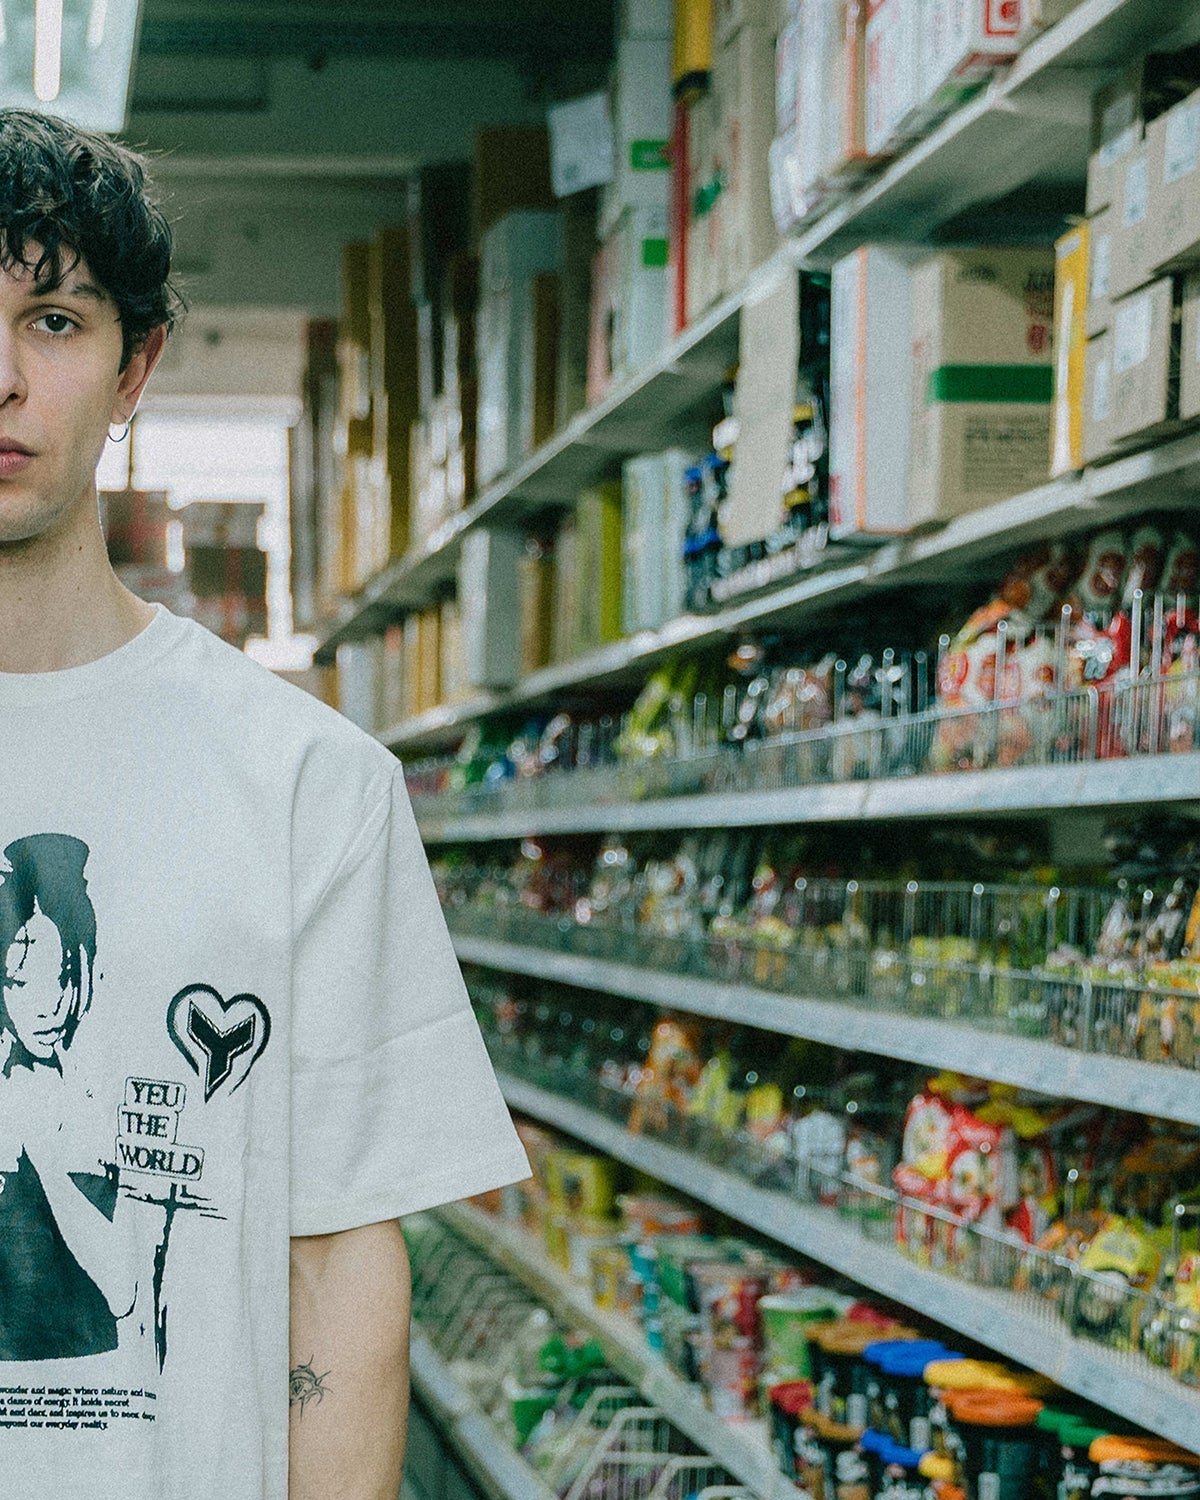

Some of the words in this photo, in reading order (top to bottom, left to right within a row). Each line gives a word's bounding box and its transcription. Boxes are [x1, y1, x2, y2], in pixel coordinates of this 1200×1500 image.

[131, 1081, 180, 1108] YEU
[122, 1111, 170, 1138] THE
[119, 1143, 200, 1175] WORLD
[31, 1386, 46, 1394] and
[48, 1387, 72, 1397] magic
[74, 1386, 99, 1395] where
[101, 1387, 128, 1396] nature
[130, 1388, 143, 1397] and
[7, 1397, 32, 1405] dance
[34, 1397, 44, 1405] of
[81, 1397, 102, 1406] holds
[104, 1398, 130, 1407] secret
[9, 1408, 25, 1416] and
[49, 1408, 64, 1417] and
[66, 1409, 96, 1418] inspires
[110, 1409, 120, 1418] to
[45, 1420, 79, 1430] everyday
